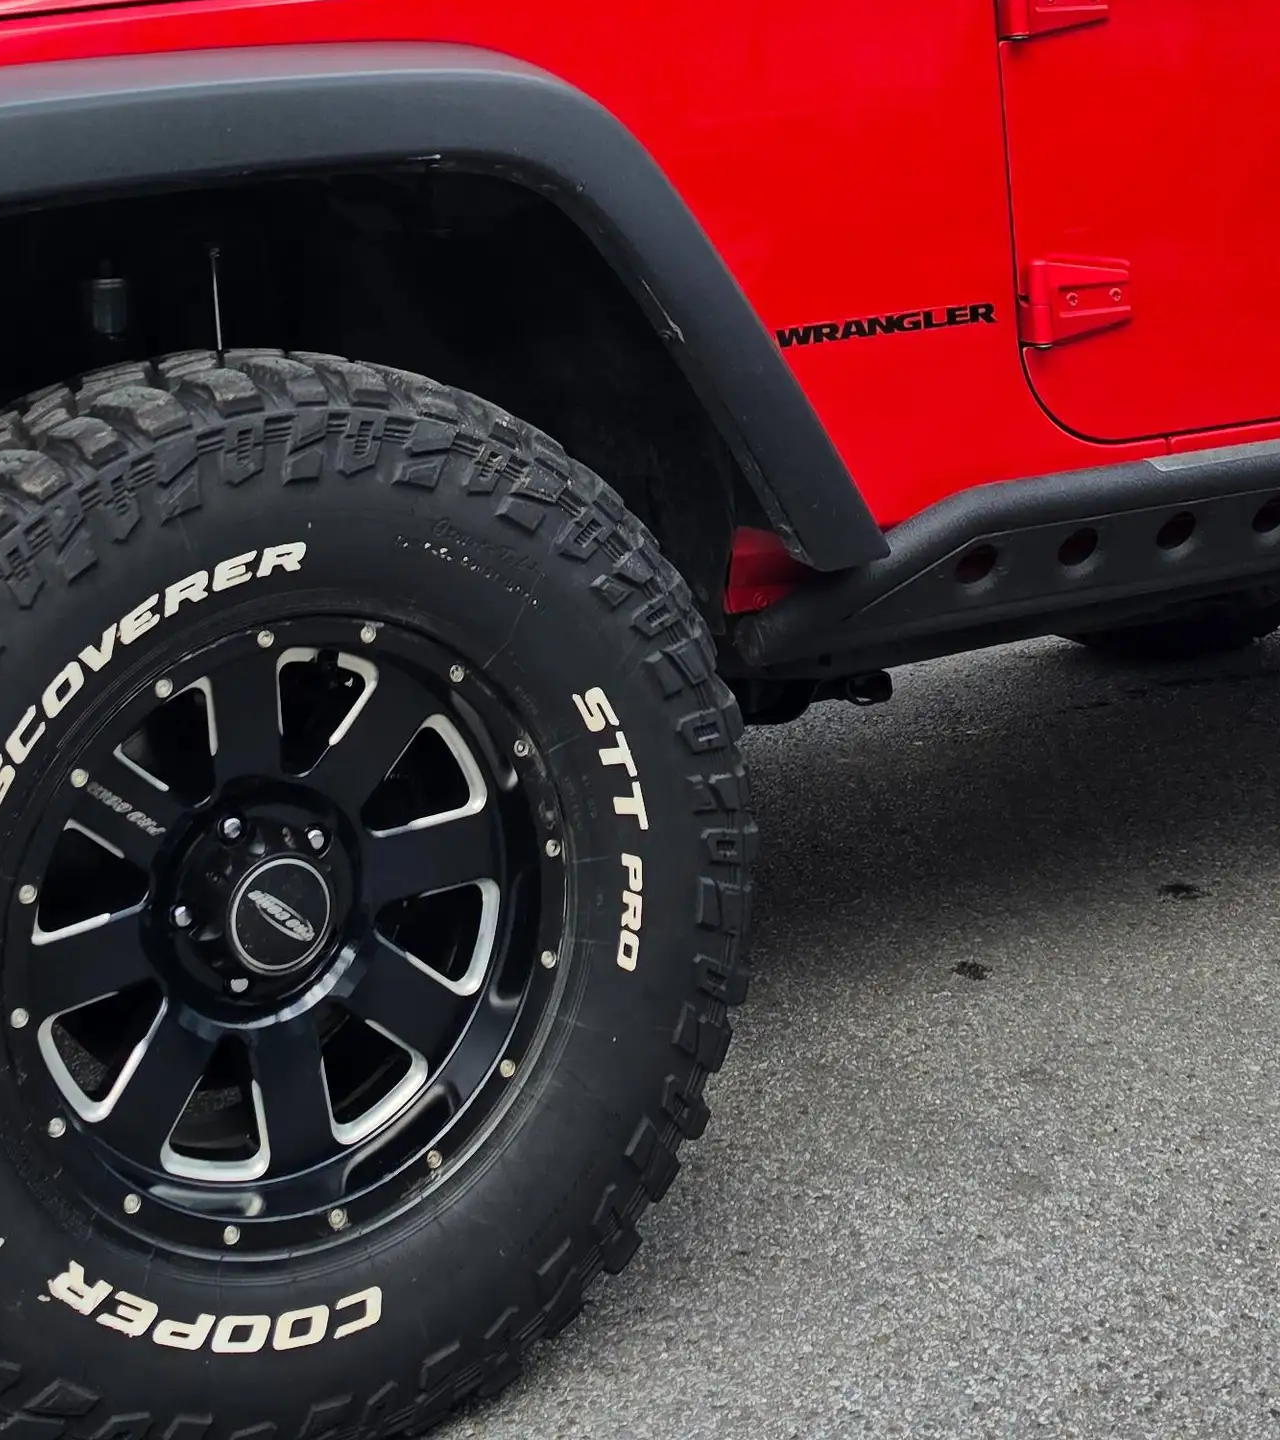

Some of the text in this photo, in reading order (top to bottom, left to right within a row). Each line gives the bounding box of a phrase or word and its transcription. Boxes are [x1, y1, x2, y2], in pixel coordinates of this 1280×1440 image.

[775, 303, 998, 348] WRANGLER
[572, 687, 649, 830] STT
[617, 853, 643, 972] PRO
[47, 1259, 383, 1353] COOPER
